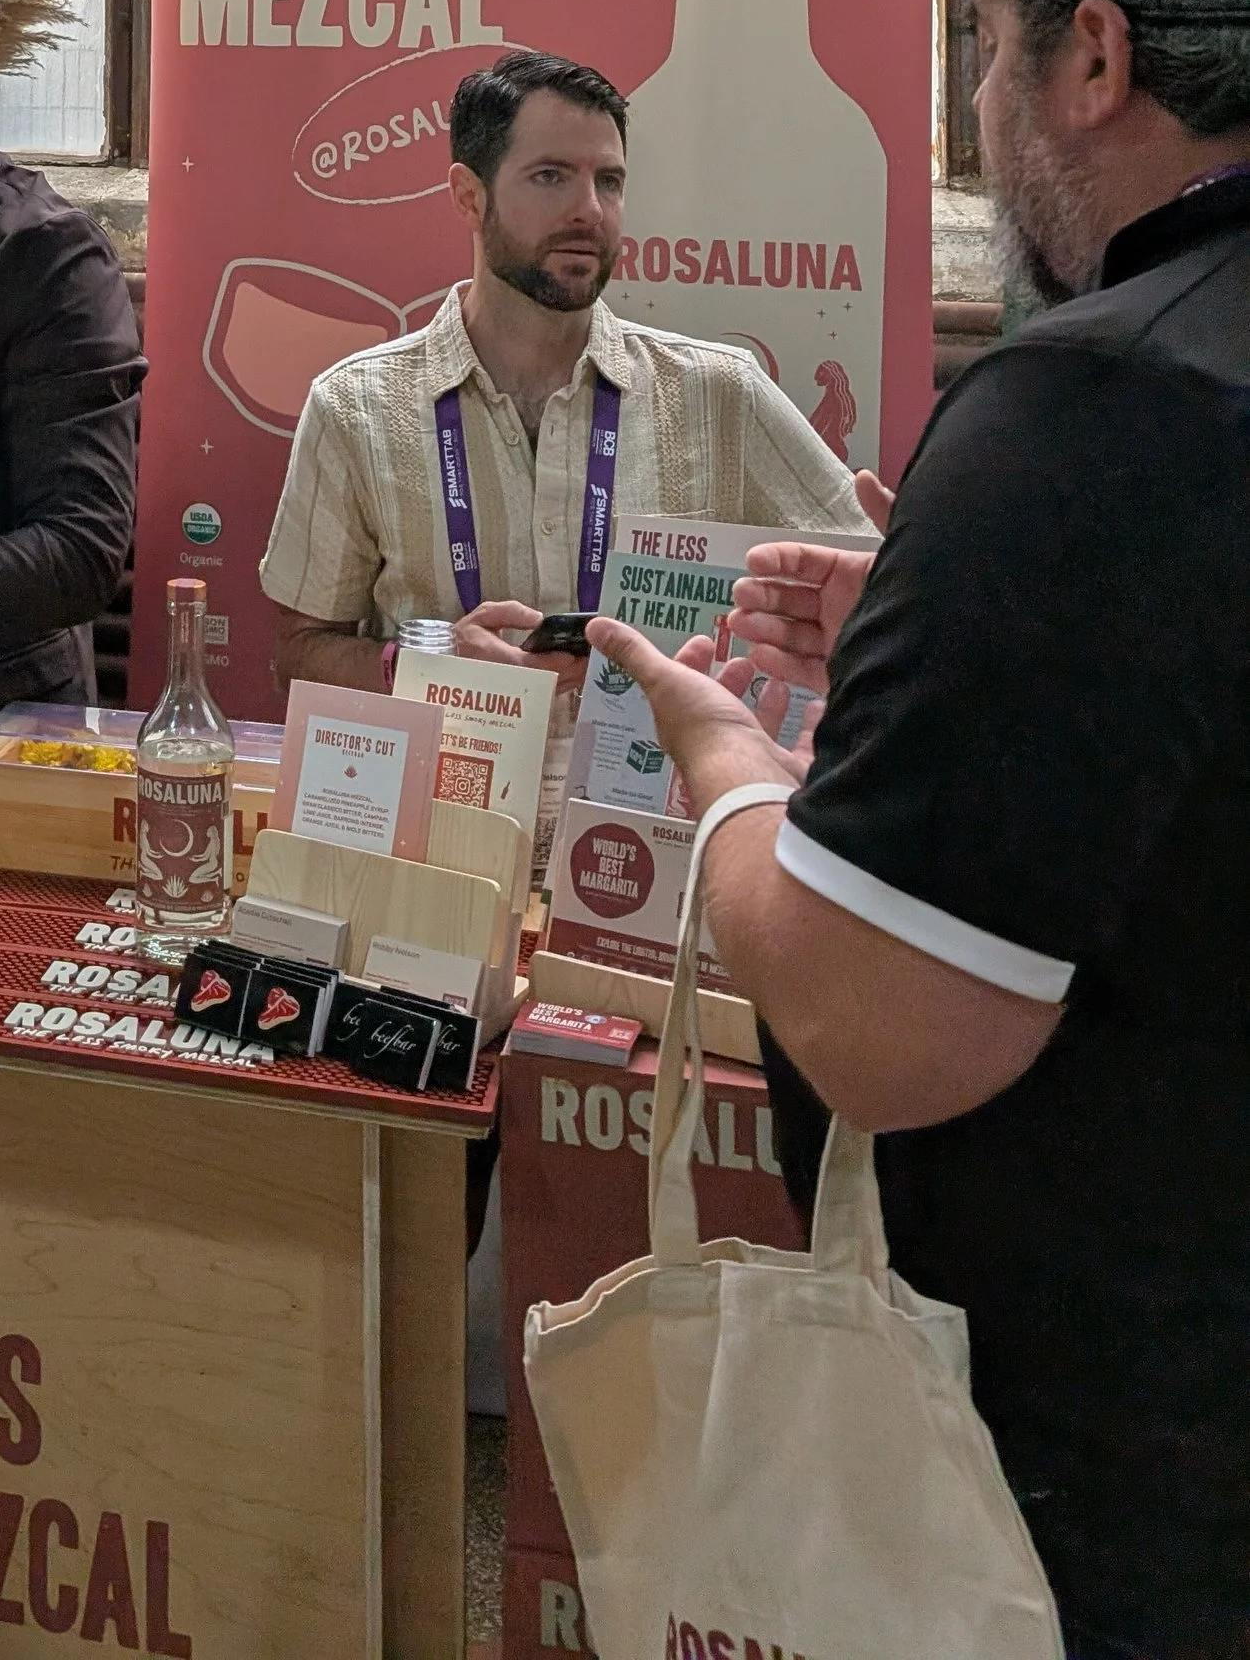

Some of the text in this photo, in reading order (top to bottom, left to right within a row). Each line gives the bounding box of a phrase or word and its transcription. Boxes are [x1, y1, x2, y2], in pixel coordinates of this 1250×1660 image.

[312, 101, 451, 178] @ROSAL
[611, 236, 862, 291] ROSALUNA
[603, 430, 617, 457] BCB
[443, 429, 459, 498] SMARTTAB
[190, 512, 213, 523] USDA
[590, 498, 608, 573] SMARTTAB
[631, 529, 708, 562] THE LESS
[180, 552, 223, 567] Organic
[452, 542, 466, 571] BCB
[619, 565, 735, 606] SUSTAINABLE
[615, 596, 700, 633] AT HEART
[426, 683, 522, 718] ROSALUNA
[315, 729, 395, 756] DIRECTOR'S CUT
[440, 733, 502, 755] ET'S BE FRIENDS!
[139, 774, 222, 805] ROSALUNA
[592, 837, 637, 861] WORLD'S
[653, 826, 695, 844] ROSALU
[111, 855, 136, 871] TH
[600, 857, 625, 877] BEST
[579, 871, 638, 899] MARGARITA
[41, 960, 181, 1000] ROSA
[50, 984, 177, 1009] THE LESS SMO
[537, 1002, 583, 1015] WORLD'S
[529, 1013, 592, 1031] MARGARITA
[532, 1008, 560, 1018] BEST
[4, 1001, 274, 1065] ROSALUNA
[12, 1026, 257, 1068] THE LESS SMOKY MEZCAL
[363, 1020, 417, 1059] beefbar
